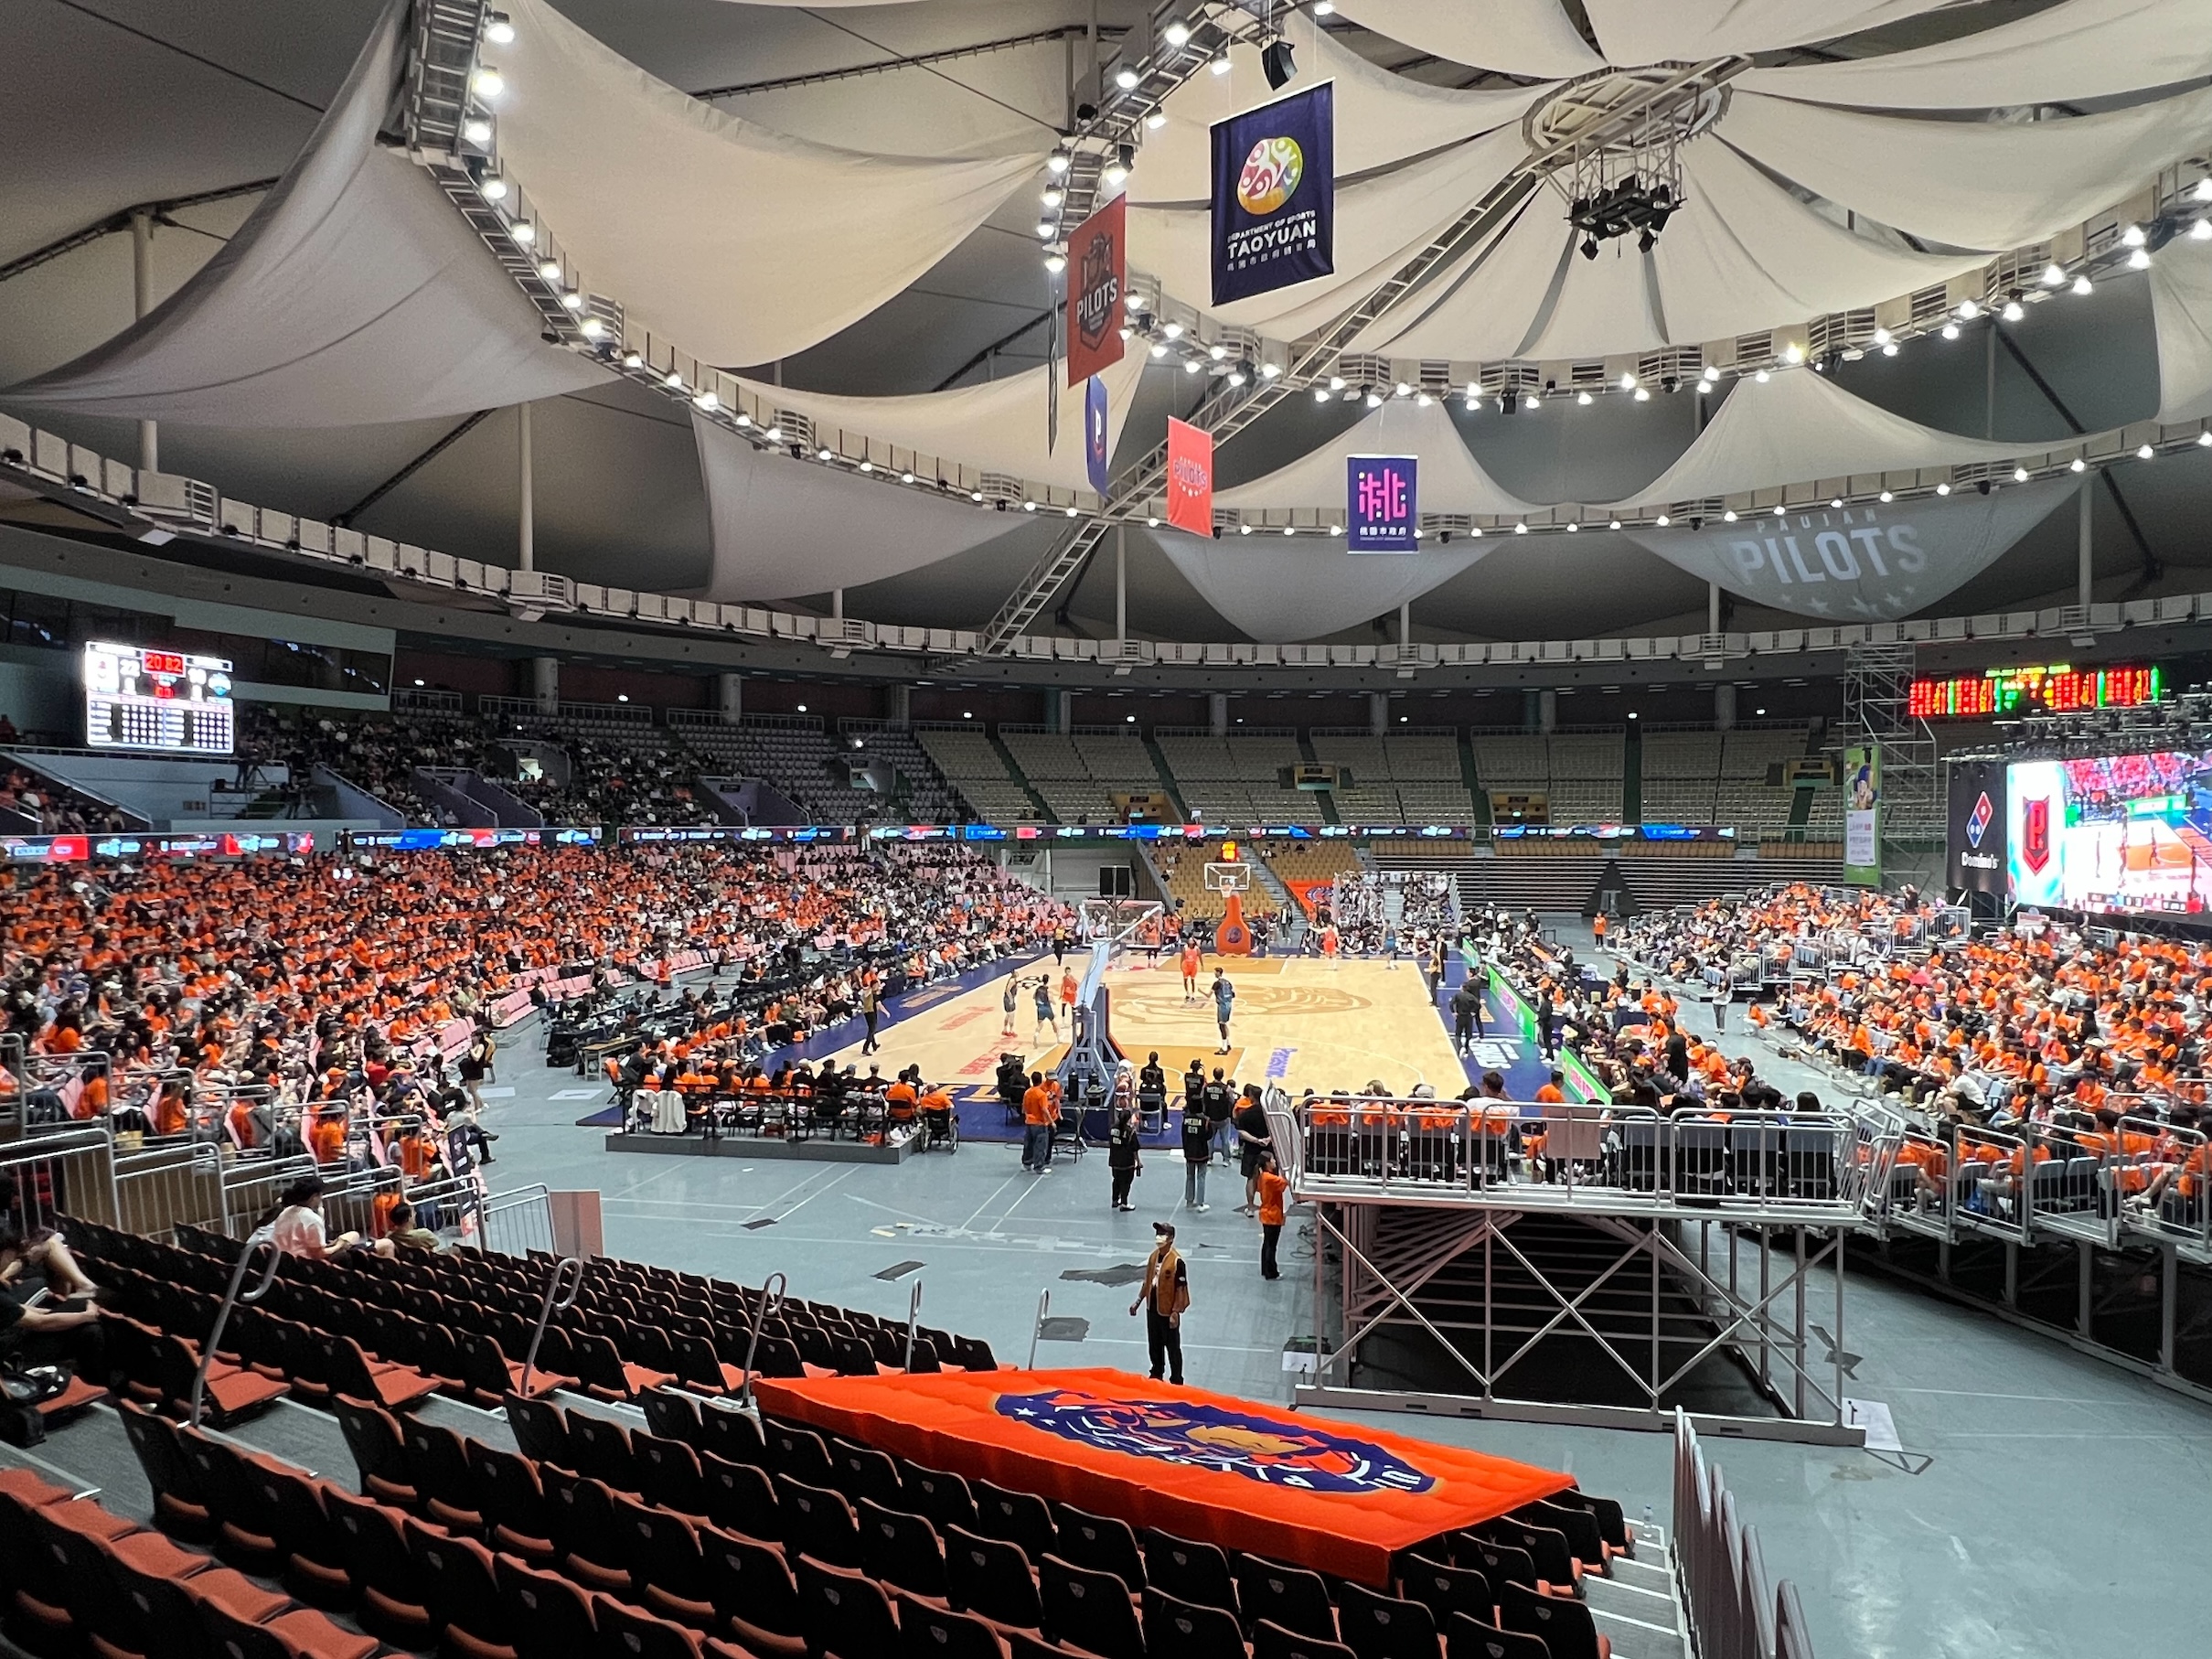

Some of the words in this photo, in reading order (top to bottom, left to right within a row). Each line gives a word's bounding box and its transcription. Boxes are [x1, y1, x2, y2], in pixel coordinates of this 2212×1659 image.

[1227, 219, 1316, 260] TAOYUAN
[1275, 218, 1286, 228] OF
[1076, 276, 1117, 325] PILOTS
[1173, 459, 1207, 489] PILOTS
[1728, 525, 1928, 585] PILOTS
[1961, 851, 2000, 869] Domino's
